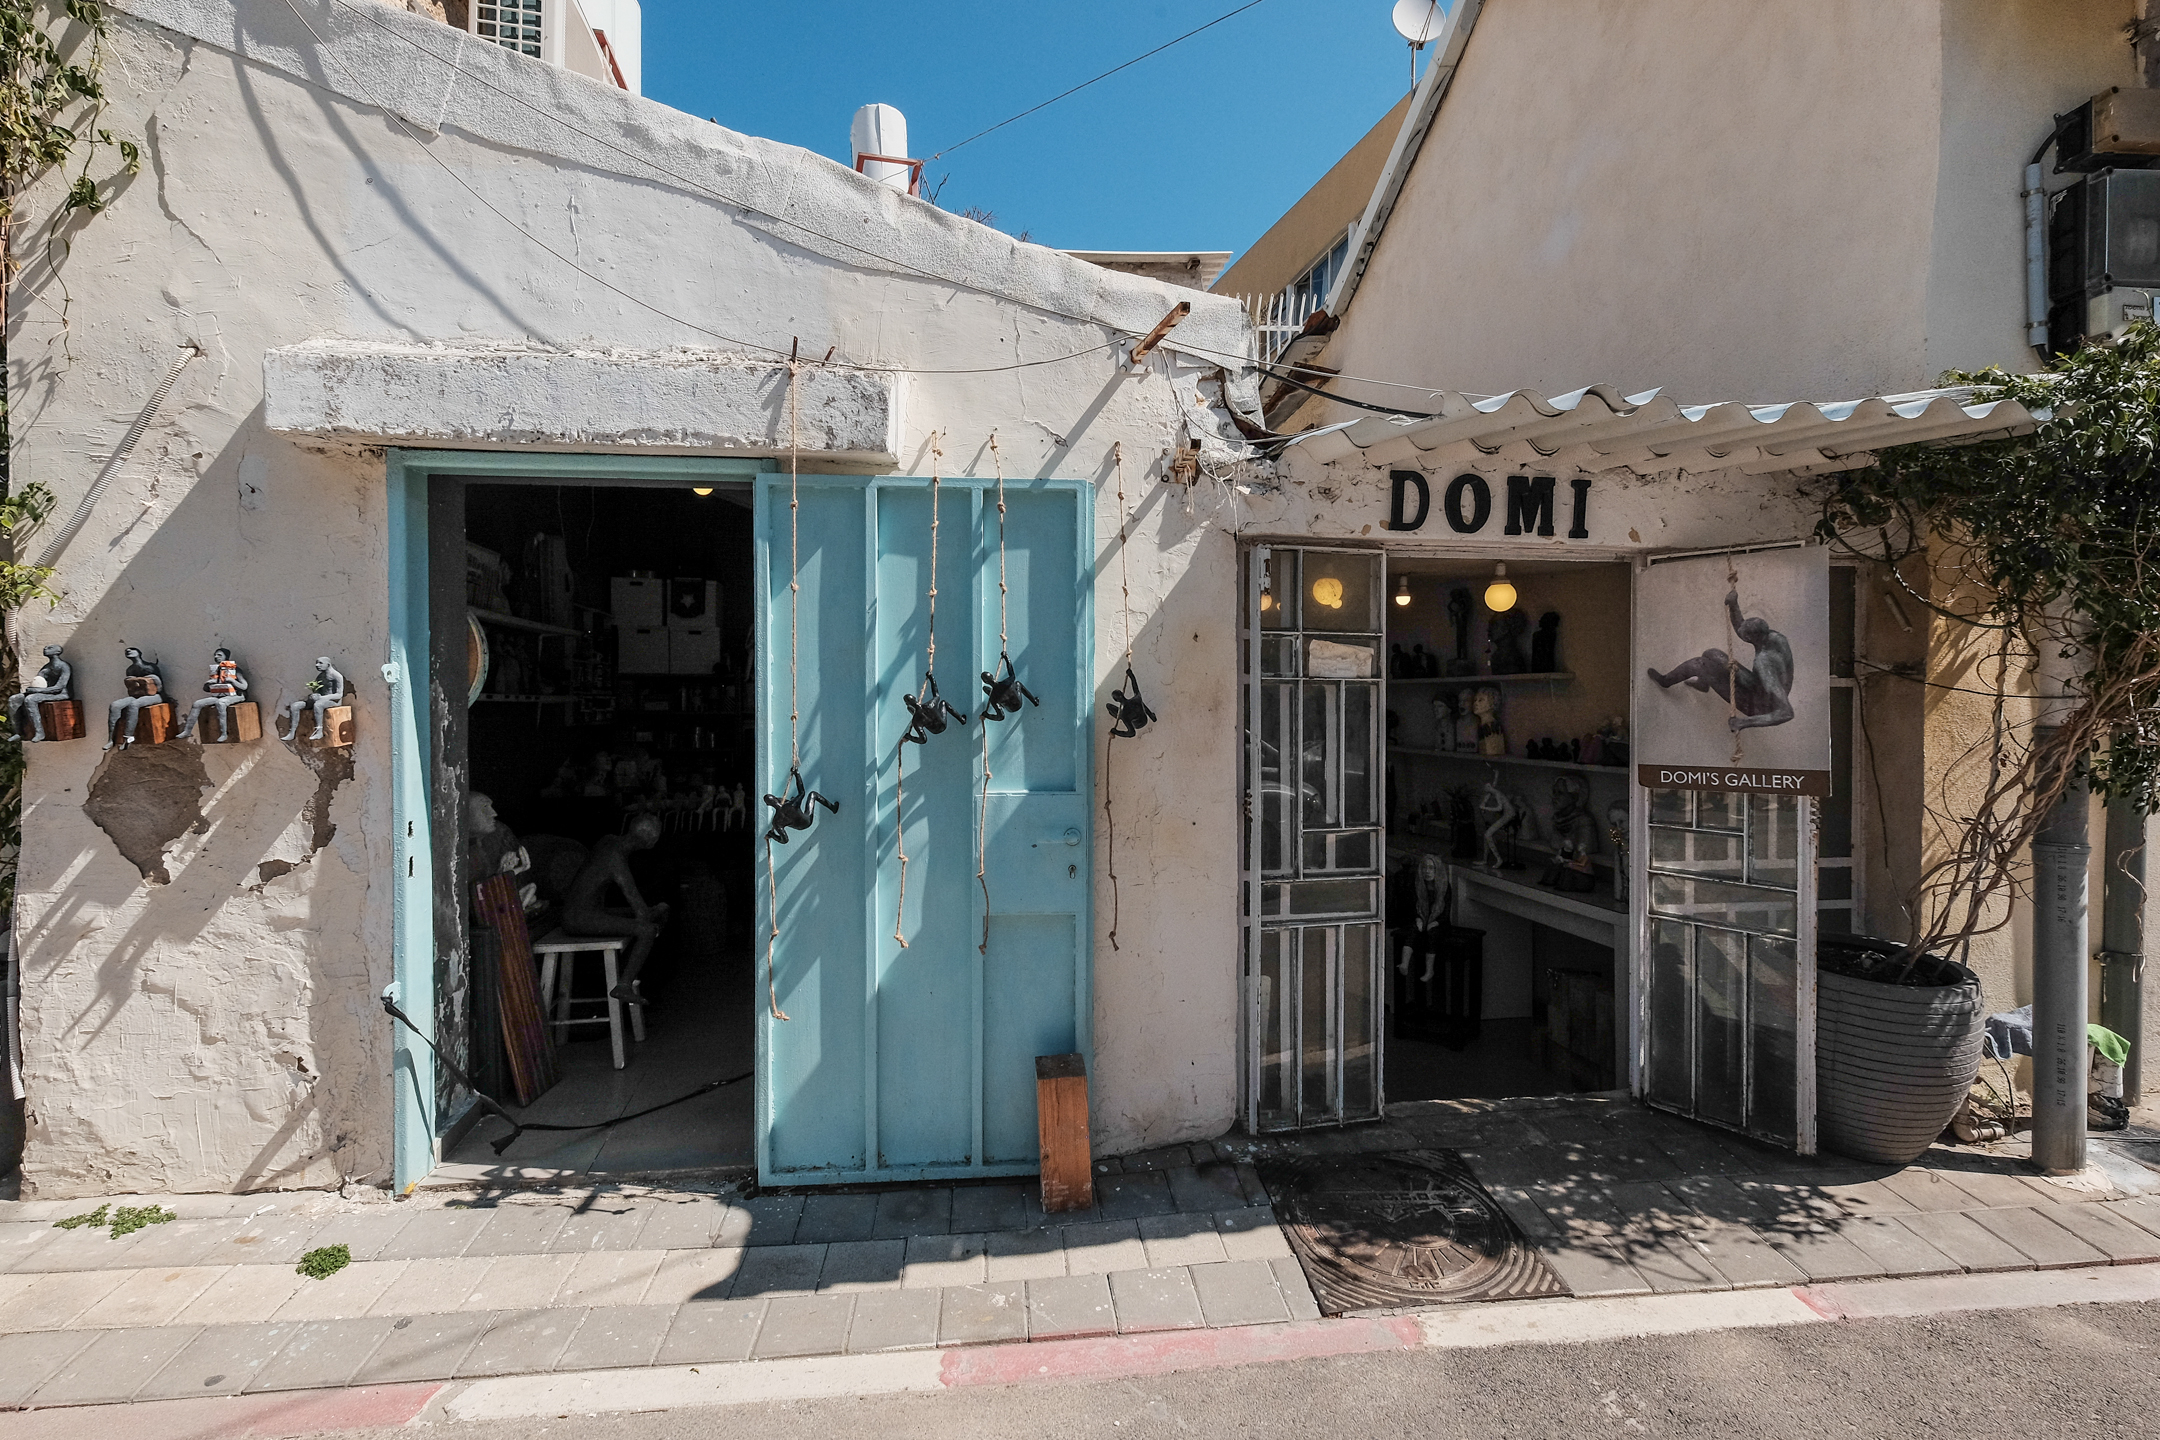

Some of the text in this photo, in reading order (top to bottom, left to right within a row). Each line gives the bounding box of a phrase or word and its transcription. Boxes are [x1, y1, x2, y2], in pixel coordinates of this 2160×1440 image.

[1388, 469, 1592, 538] DOMI
[1660, 770, 1805, 790] DOMI'S GALLERY
